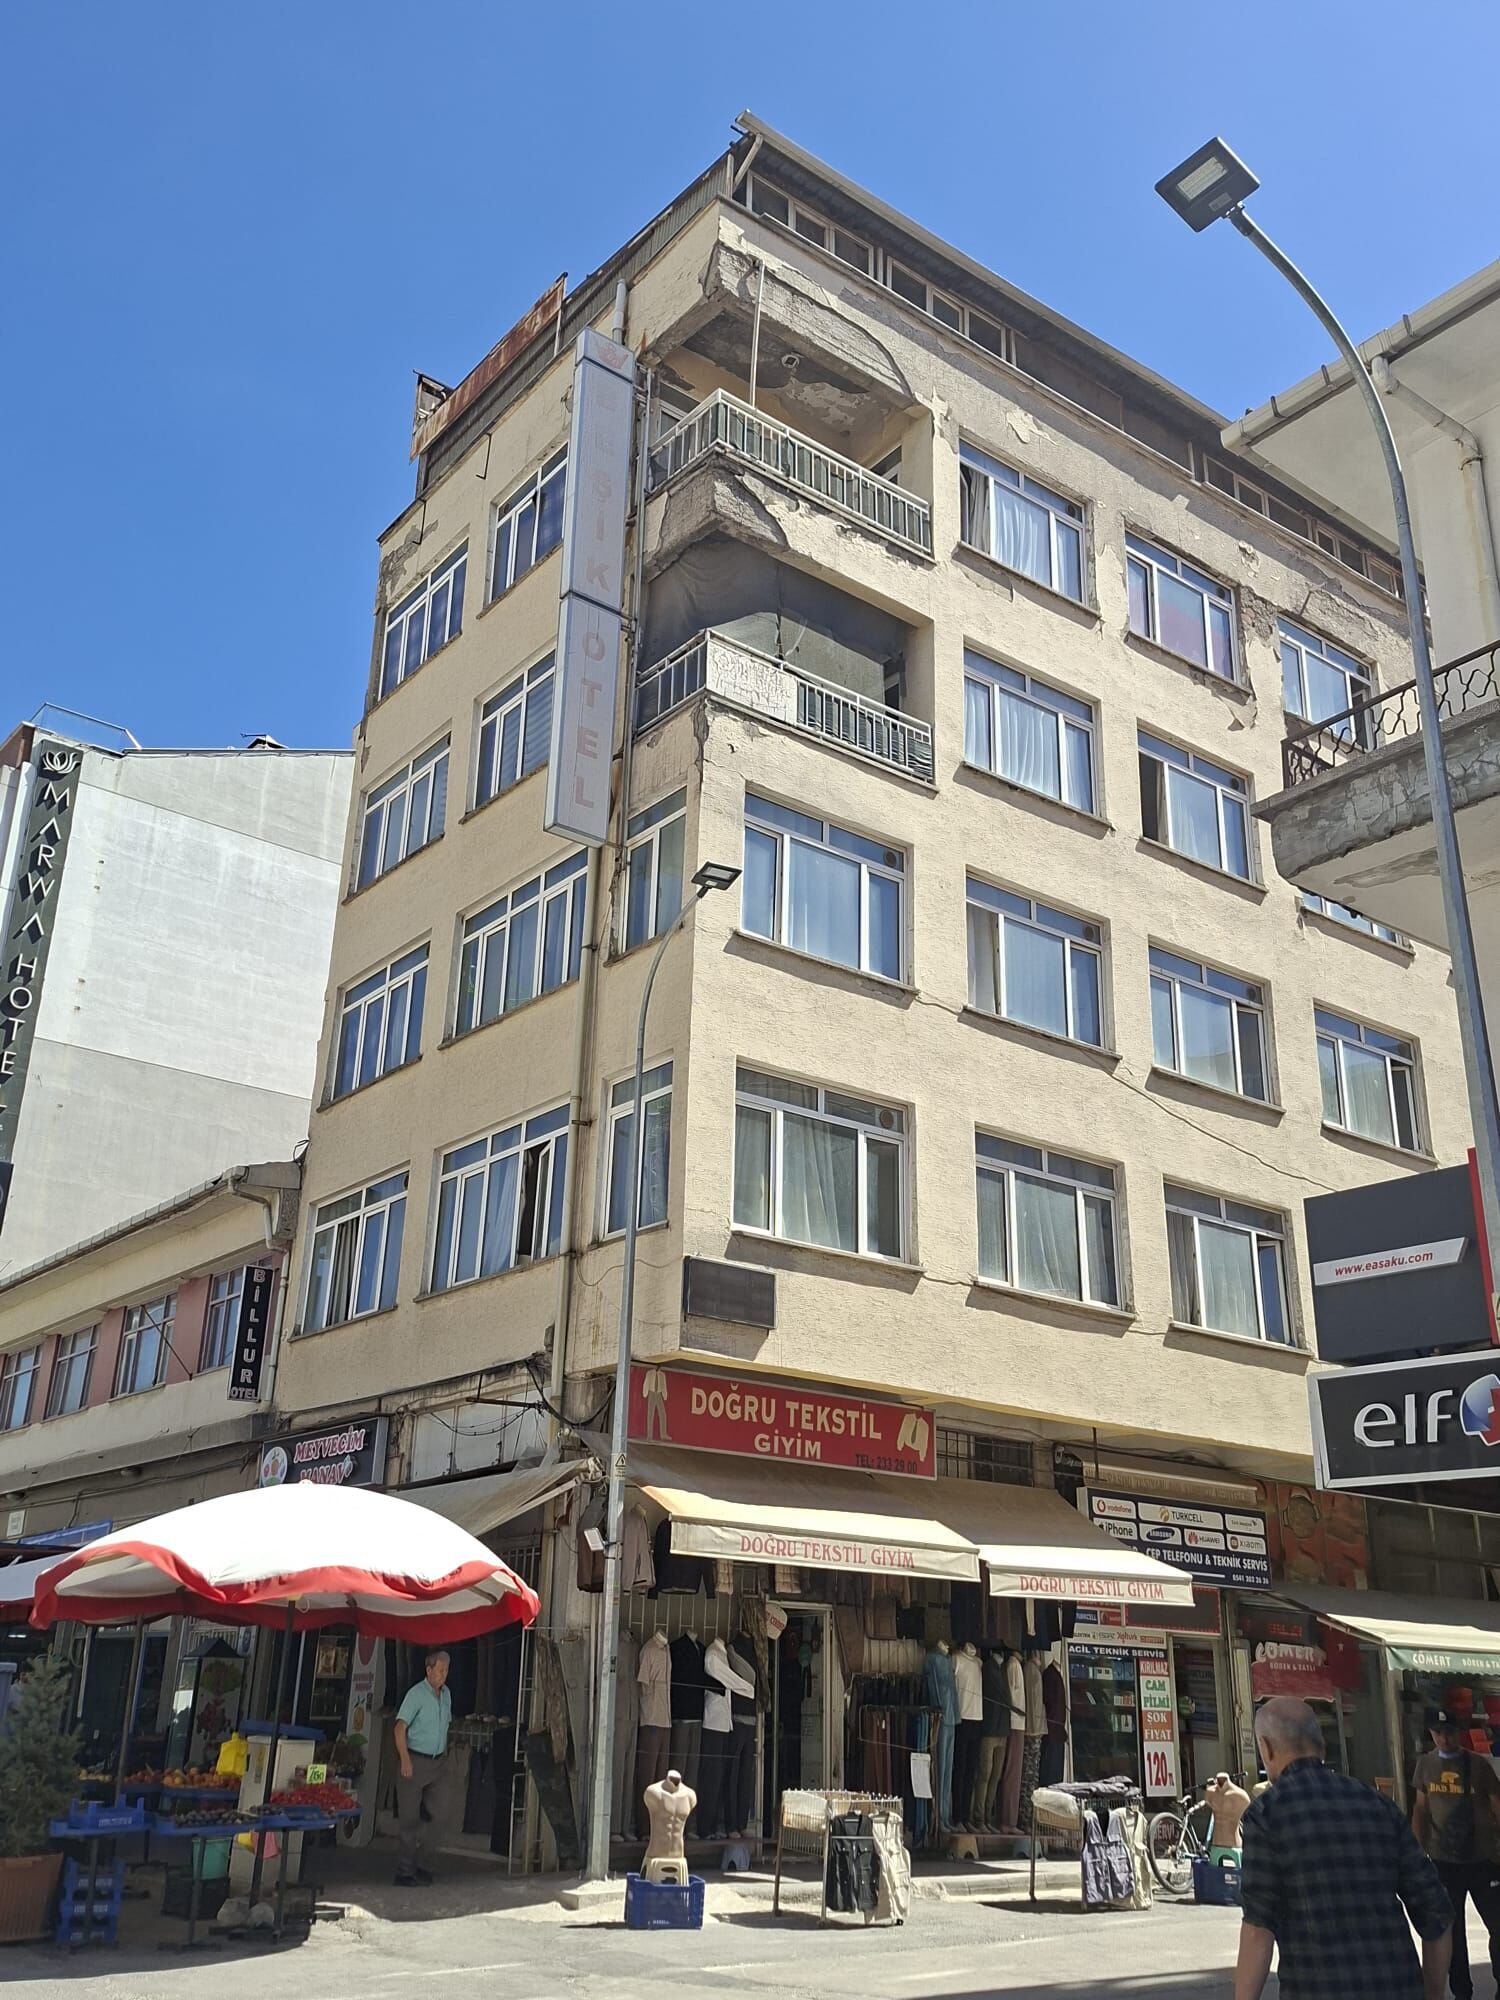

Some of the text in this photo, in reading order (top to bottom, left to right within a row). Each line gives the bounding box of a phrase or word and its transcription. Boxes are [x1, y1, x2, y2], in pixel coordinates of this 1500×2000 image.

[576, 632, 606, 809] OTEL
[22, 781, 71, 937] MARWA
[1335, 1251, 1433, 1276] www.easaku.com
[240, 1269, 265, 1383] BİLLUR
[230, 1387, 258, 1400] OTEL
[691, 1383, 882, 1440] DOĞRU TEKSTİL
[1354, 1389, 1453, 1448] elf
[294, 1425, 365, 1463] MEYVECİM
[754, 1429, 821, 1460] GİYİM
[856, 1454, 874, 1469] TEL:
[877, 1456, 892, 1470] 233
[1106, 1503, 1132, 1514] vodafone
[1172, 1511, 1204, 1523] TURKCELL
[1105, 1524, 1134, 1538] iPhone
[1149, 1528, 1174, 1538] SAMSUNG
[1199, 1536, 1221, 1545] HUAWEI
[740, 1534, 915, 1569] DOĞRU TEKSTİL GİYİM
[1162, 1549, 1203, 1565] TELEFONU
[1205, 1555, 1212, 1566] &
[1213, 1554, 1241, 1569] TEKNİK
[1243, 1557, 1268, 1572] SERVİS
[1070, 1578, 1125, 1597] TEKSTİL
[1128, 1580, 1165, 1599] GİYİM
[1069, 1643, 1165, 1658] ACİL TEKNİK SERVİS
[1413, 1650, 1451, 1667] CÖMERT
[1145, 1679, 1166, 1692] CAM
[1147, 1711, 1167, 1725] ŞOK
[1147, 1751, 1168, 1787] 120
